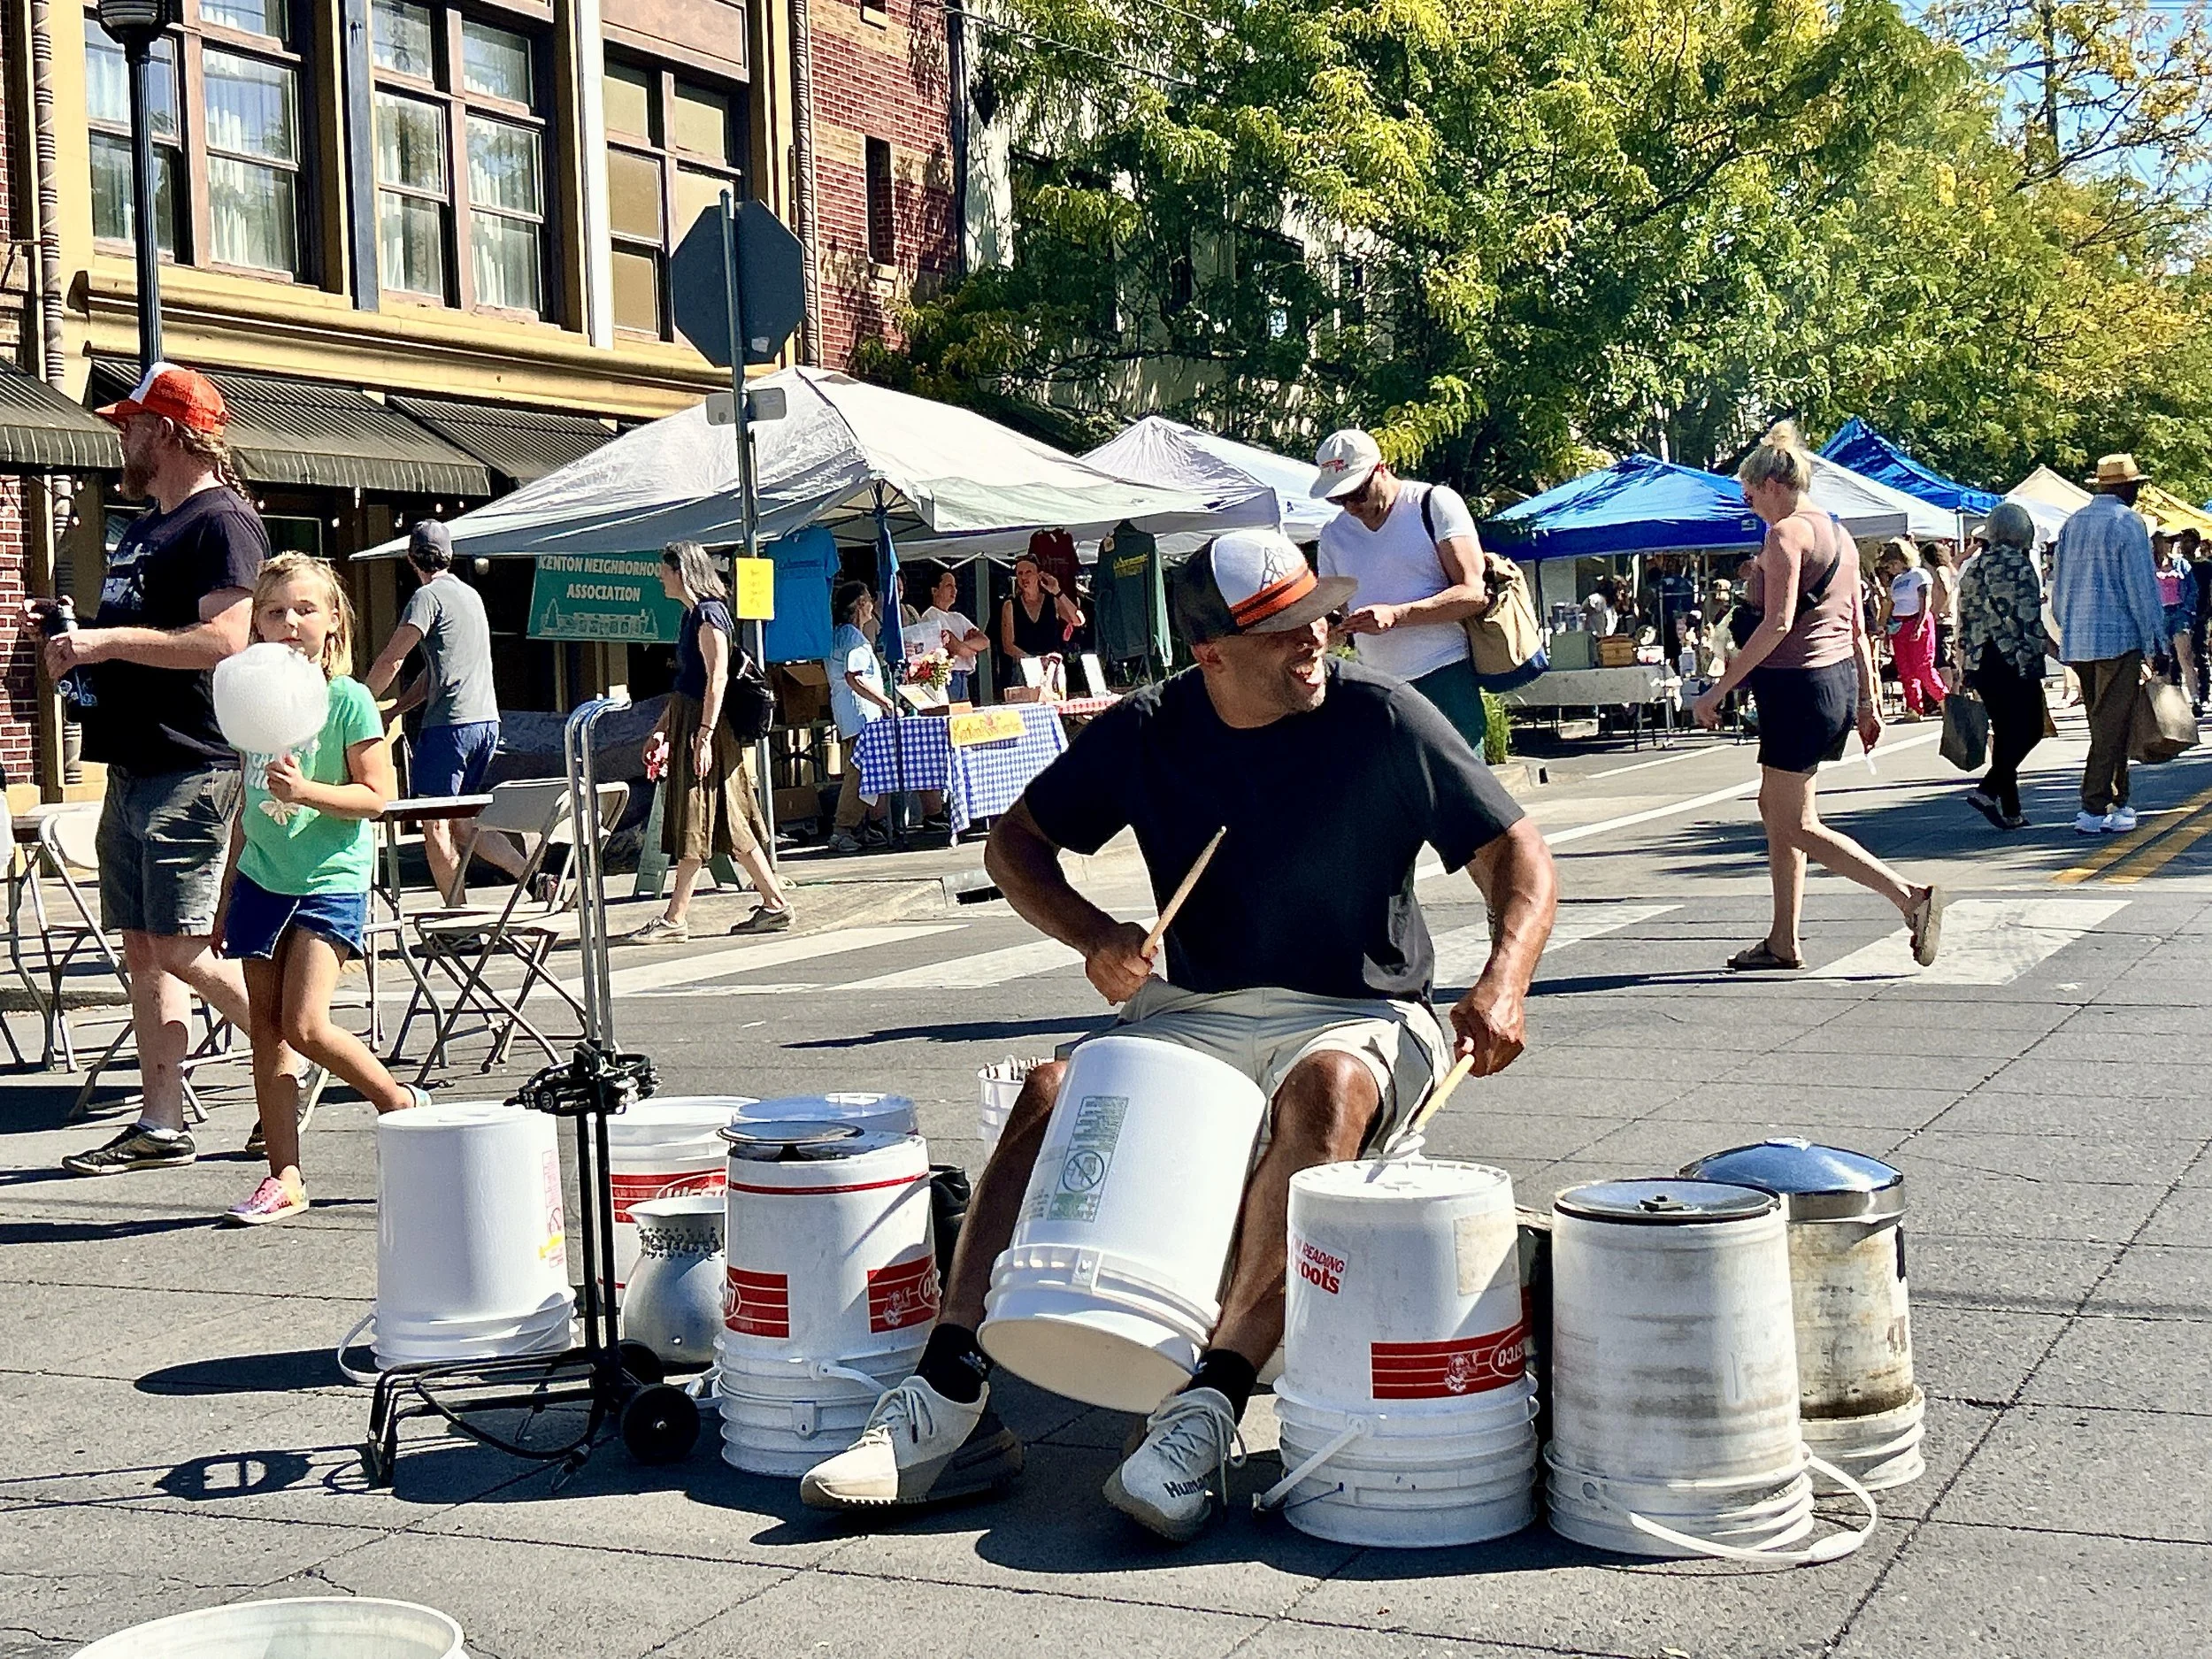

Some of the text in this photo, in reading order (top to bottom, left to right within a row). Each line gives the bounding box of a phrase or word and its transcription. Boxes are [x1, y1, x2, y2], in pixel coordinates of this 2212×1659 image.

[538, 555, 662, 577] KENTON NEIGHBORHOO
[567, 583, 641, 602] ASSOCIATION
